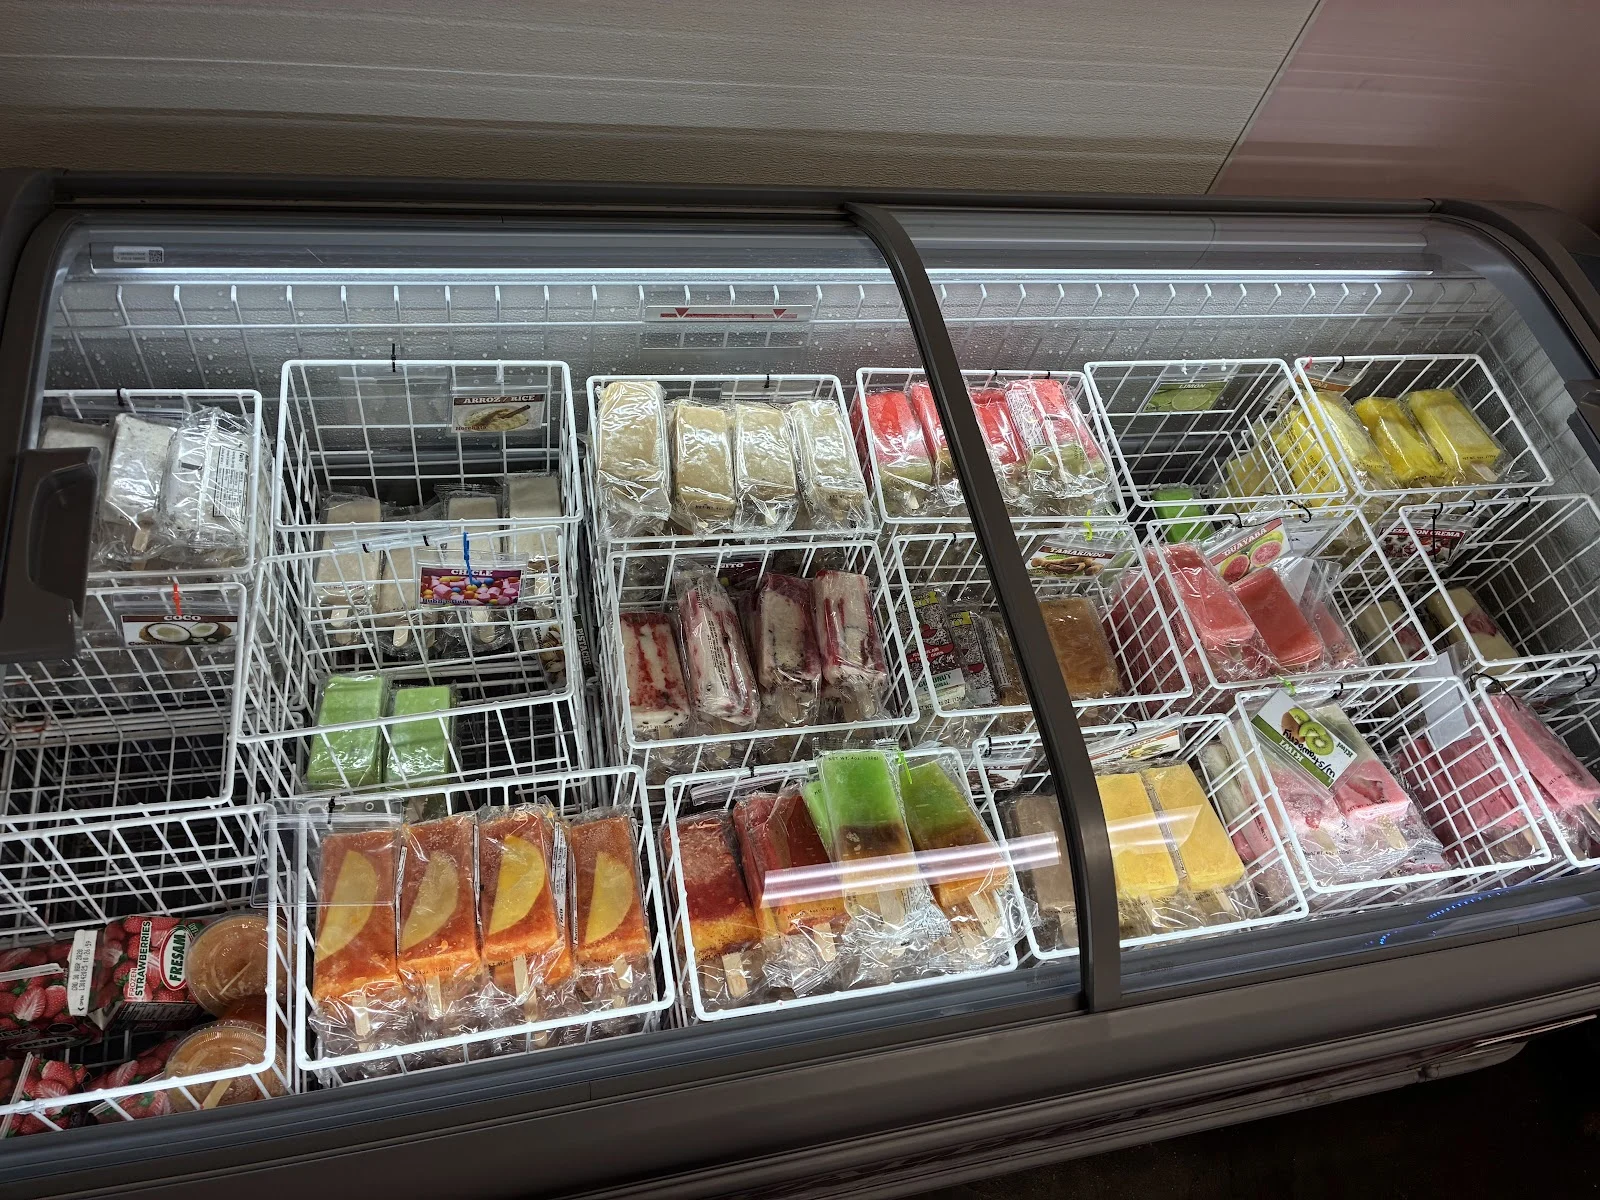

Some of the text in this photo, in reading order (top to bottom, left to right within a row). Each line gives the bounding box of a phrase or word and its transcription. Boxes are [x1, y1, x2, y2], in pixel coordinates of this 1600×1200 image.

[1050, 546, 1106, 558] TAMARINDO
[450, 568, 493, 576] CHCLE
[575, 627, 593, 666] PISTACHE
[1278, 739, 1305, 762] KIWI
[1281, 728, 1336, 778] w/strawberry
[1336, 741, 1354, 759] Kiwi
[135, 921, 151, 996] STRAWBERRIES
[169, 934, 186, 982] FRESAM
[128, 968, 138, 997] FROZEN
